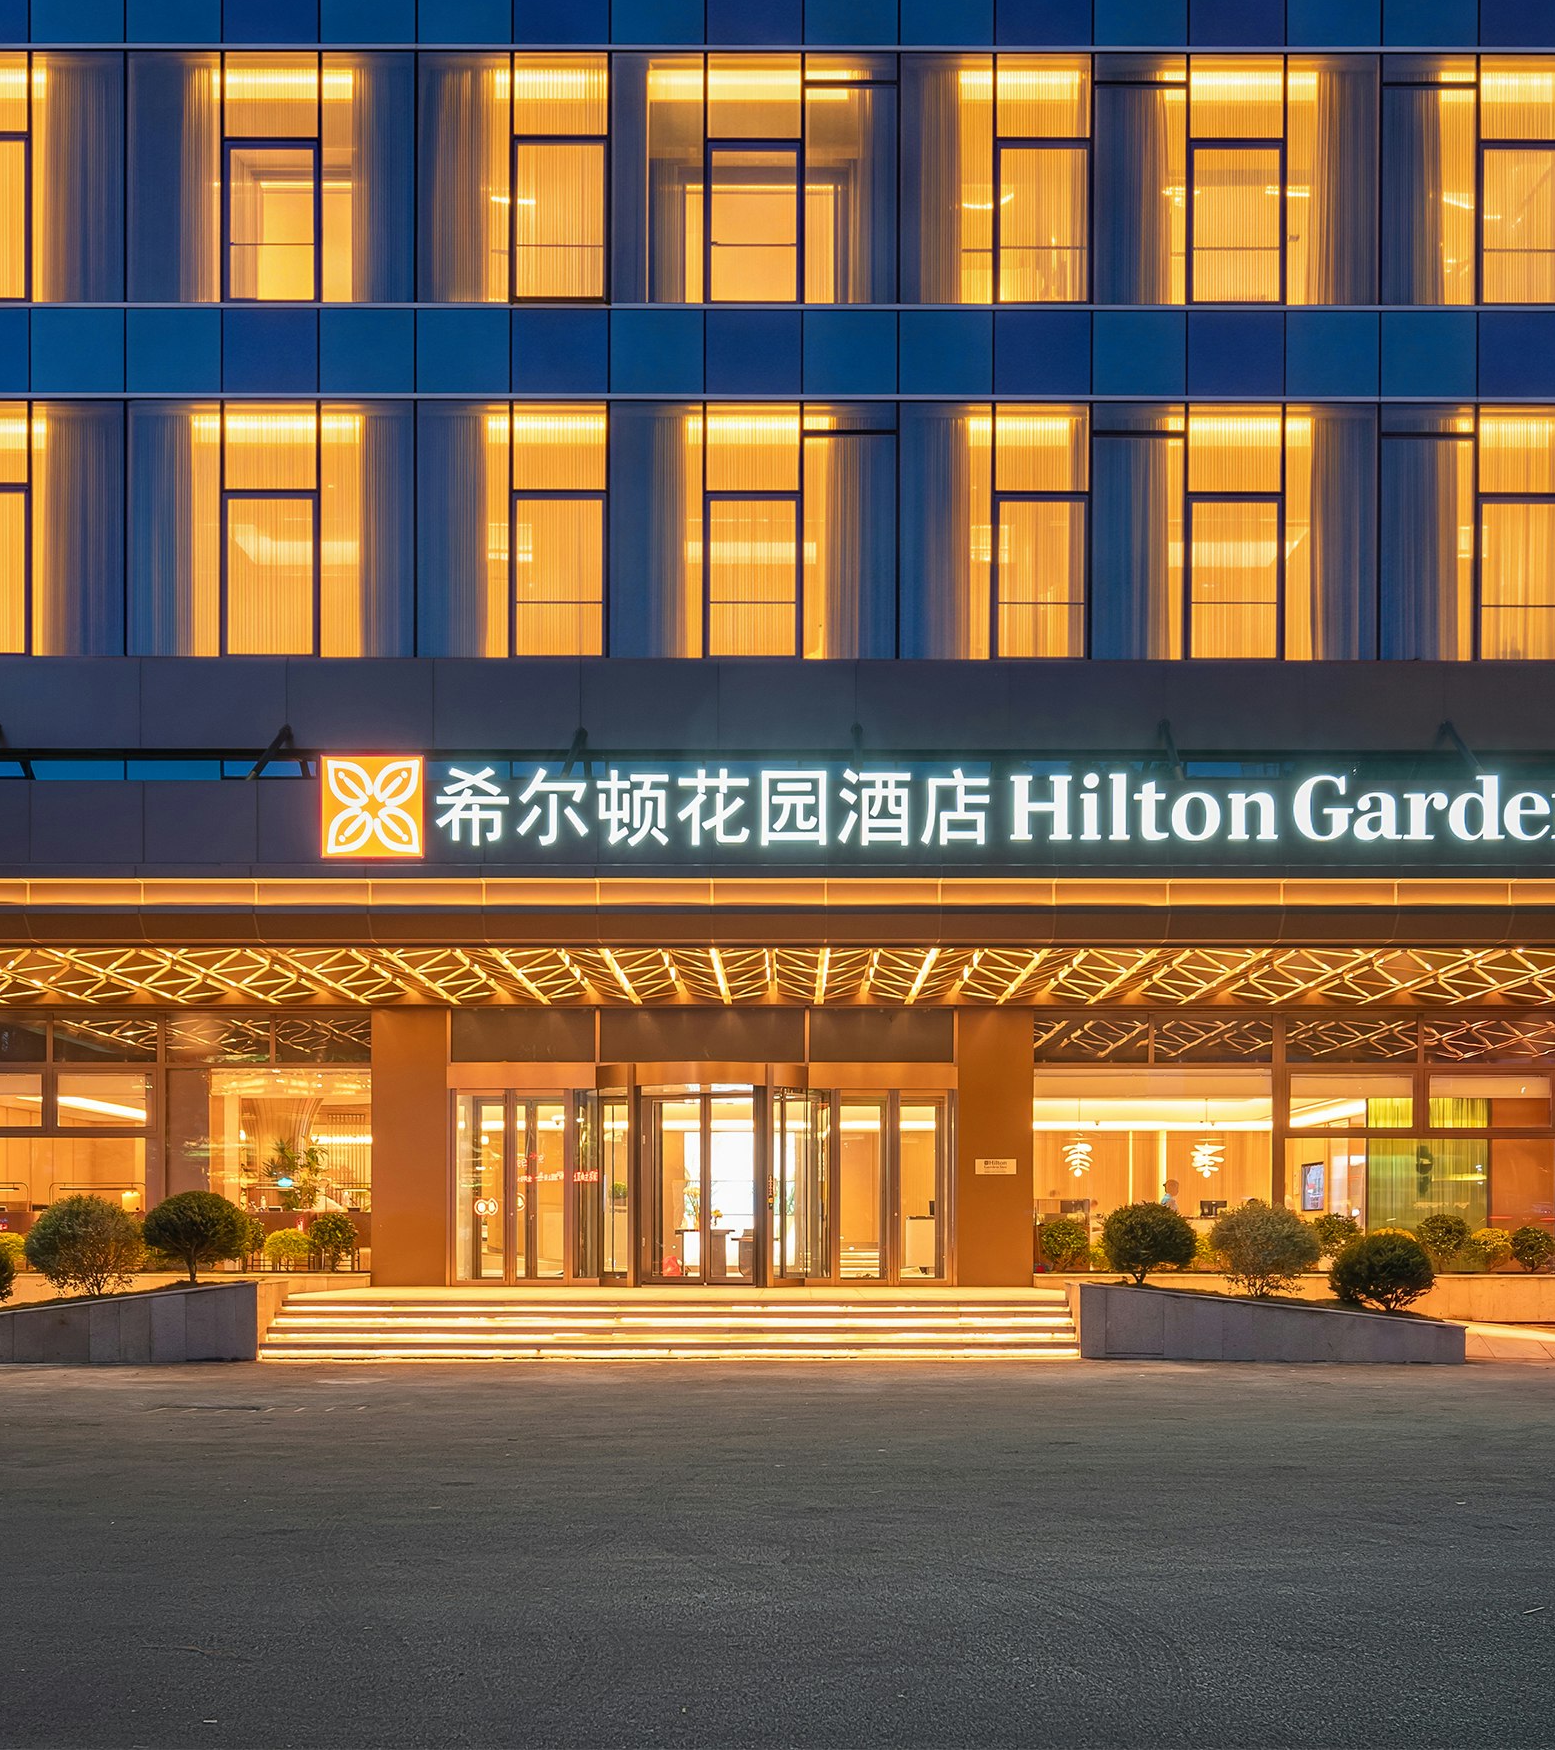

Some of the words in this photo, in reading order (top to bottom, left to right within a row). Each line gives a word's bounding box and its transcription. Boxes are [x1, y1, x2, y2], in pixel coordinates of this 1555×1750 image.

[434, 766, 991, 847] 希尔顿花园酒店
[1008, 772, 1280, 841] Hilton
